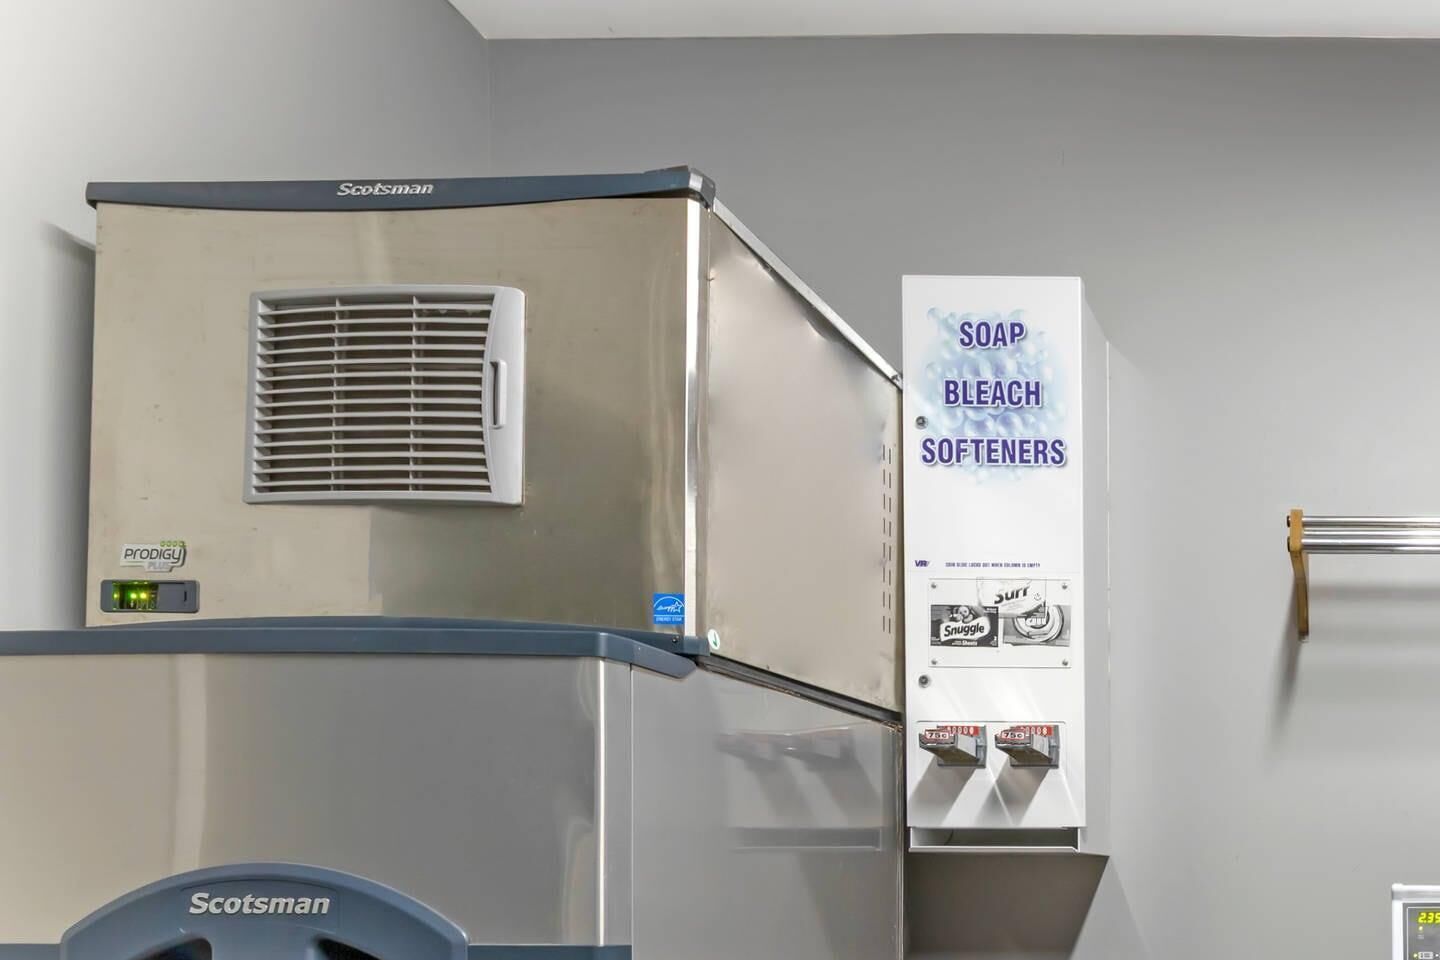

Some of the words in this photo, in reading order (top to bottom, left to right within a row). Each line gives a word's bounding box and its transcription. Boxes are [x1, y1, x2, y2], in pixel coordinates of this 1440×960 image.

[337, 182, 434, 196] Scotsman
[959, 320, 1025, 347] SOAP
[944, 380, 1041, 406] BLEACH
[921, 437, 1066, 465] SOFTENERS
[944, 622, 985, 637] Snuggle
[189, 892, 330, 914] Scotsman
